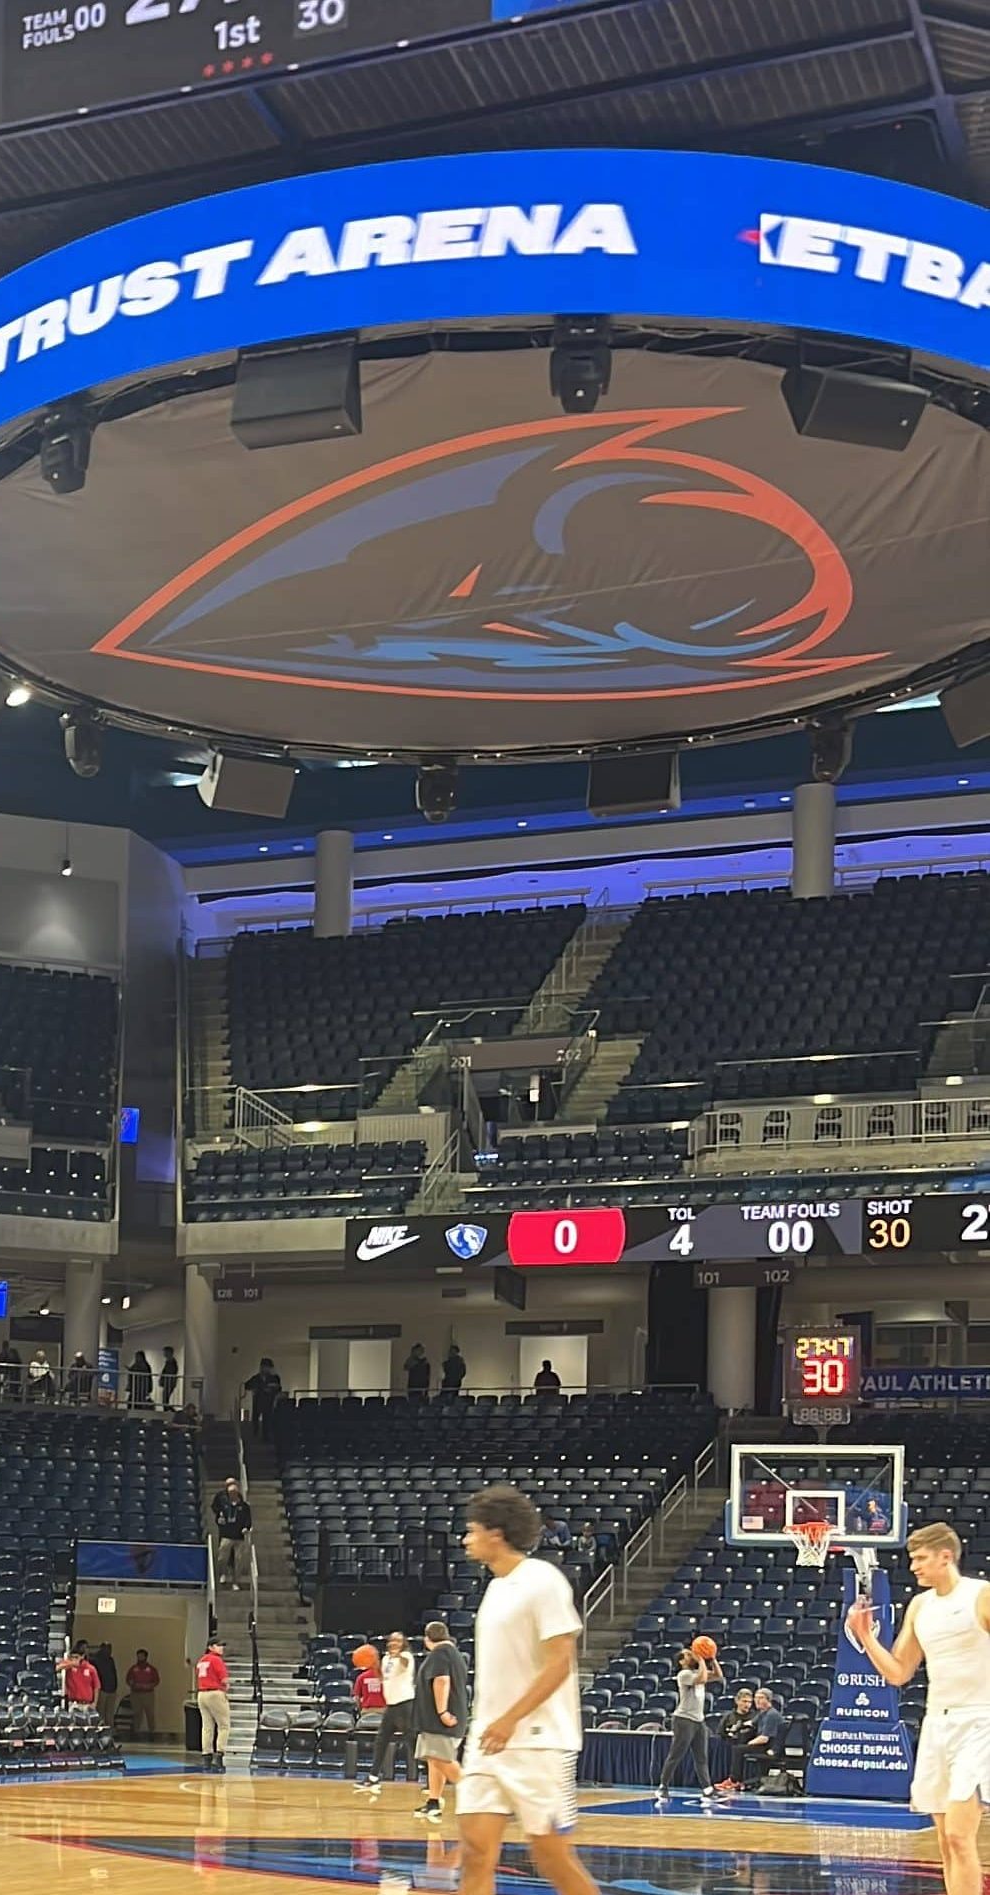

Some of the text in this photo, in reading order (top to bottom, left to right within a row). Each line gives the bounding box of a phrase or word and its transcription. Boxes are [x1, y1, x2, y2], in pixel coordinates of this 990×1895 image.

[22, 8, 68, 32] TEAM
[74, 2, 106, 31] 00
[297, 0, 345, 30] 30
[22, 23, 76, 49] FOULS
[214, 15, 261, 50] 1st
[255, 204, 638, 286] ARENA
[451, 1056, 471, 1068] 201
[667, 1208, 696, 1221] TOL
[741, 1202, 841, 1220] TEAM FOULS
[867, 1200, 913, 1215] SHOT
[868, 1218, 911, 1249] 30
[961, 1204, 990, 1241] 2
[366, 1225, 409, 1246] NIKE
[554, 1219, 578, 1254] 0
[669, 1224, 694, 1256] 4
[768, 1220, 814, 1253] 00
[697, 1269, 790, 1285] 101 102
[795, 1336, 851, 1359] 27:47
[803, 1359, 845, 1394] 30
[850, 1673, 886, 1687] RUSH
[836, 1707, 889, 1718] RUBICON
[819, 1743, 861, 1754] CHOOSE
[813, 1756, 908, 1771] choose.depaul.edu
